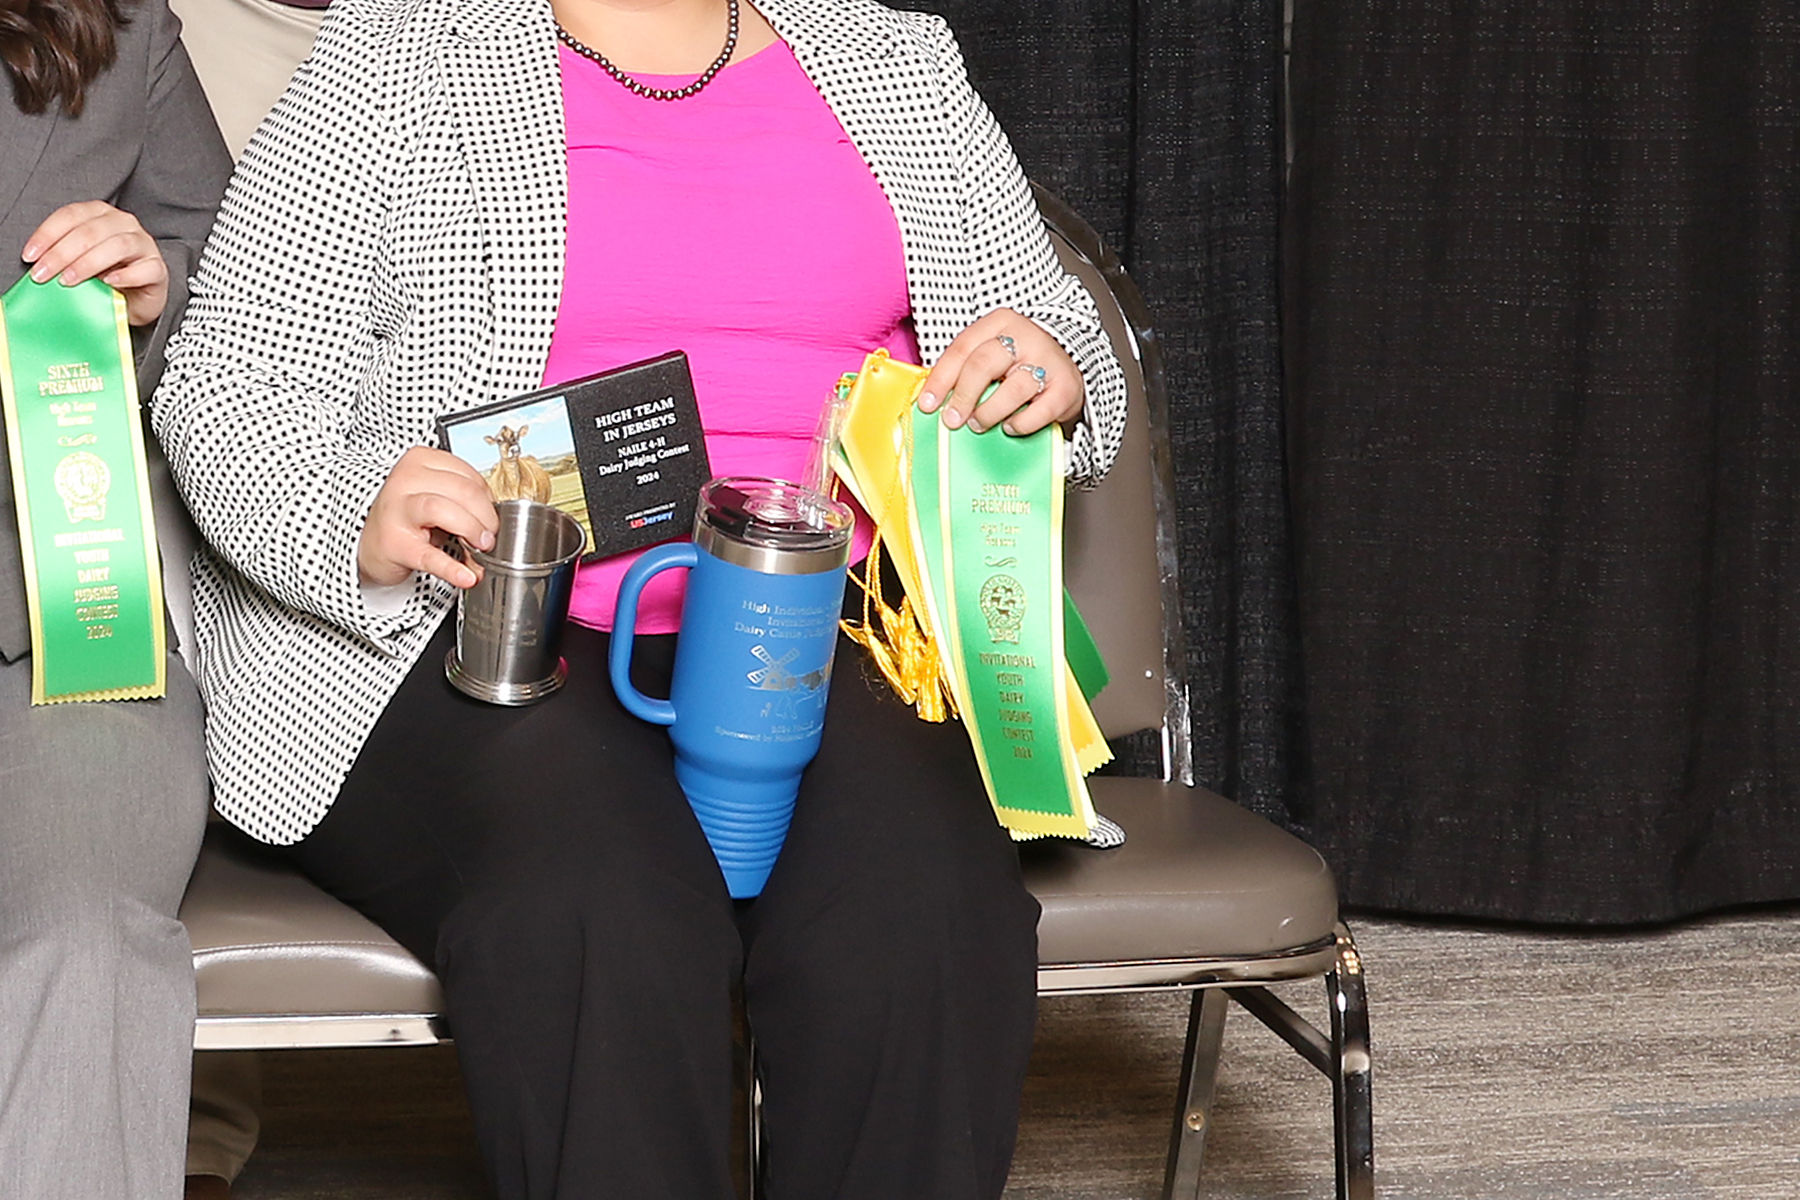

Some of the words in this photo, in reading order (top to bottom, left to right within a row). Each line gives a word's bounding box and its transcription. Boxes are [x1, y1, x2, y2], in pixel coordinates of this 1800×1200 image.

[47, 362, 90, 380] SIXTH
[38, 376, 104, 397] PREMIUM
[595, 408, 633, 428] HIGH
[633, 396, 674, 417] TEAM
[603, 428, 620, 442] IN
[621, 412, 677, 439] JERSEYS
[617, 441, 648, 458] NAILE
[648, 436, 666, 449] 4-H
[598, 462, 624, 476] Dairy
[623, 453, 658, 471] Judging
[656, 443, 690, 459] Contest
[635, 471, 661, 485] 2024
[981, 483, 1019, 498] SIXTH
[971, 498, 1031, 515] PREMIUM
[630, 511, 674, 529] USJersey
[54, 528, 125, 547] INVITATIONAL
[73, 548, 110, 564] YOUTH
[77, 566, 110, 583] DAIRY
[74, 585, 119, 603] JUDGING
[76, 603, 119, 622] CONTEST
[742, 600, 771, 615] High
[86, 625, 113, 640] 2024
[734, 621, 766, 638] Dairy
[979, 653, 1036, 668] INVITATIONAL
[996, 672, 1024, 686] YOUTH
[999, 691, 1025, 704] DAIRY
[999, 709, 1032, 723] JUDGING
[1003, 727, 1036, 741] CONTEST
